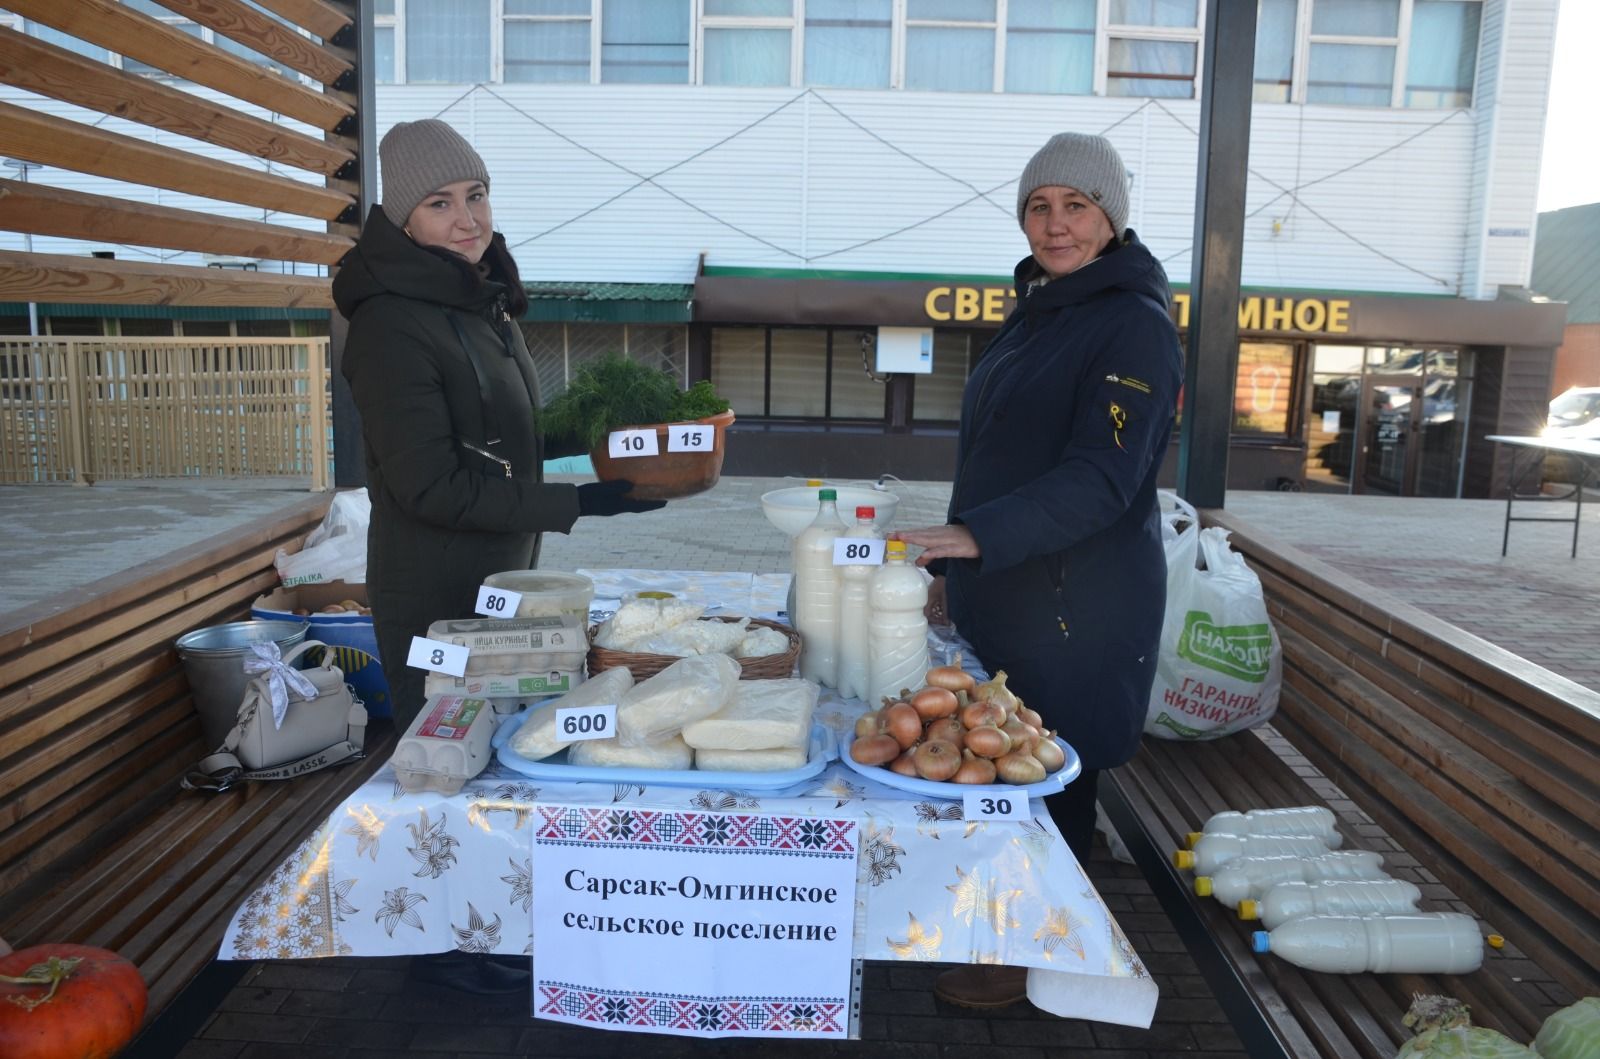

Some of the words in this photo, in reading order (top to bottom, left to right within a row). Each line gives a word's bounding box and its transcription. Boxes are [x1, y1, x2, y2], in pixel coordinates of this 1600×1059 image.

[925, 287, 1017, 322] СВЕ
[1172, 293, 1350, 333] ТМНОЕ
[621, 436, 645, 451] 10
[681, 432, 702, 447] 15
[846, 544, 871, 559] 80
[486, 594, 506, 612] 80
[495, 634, 529, 645] КУРИНЫЕ
[430, 649, 445, 666] 8
[1182, 677, 1261, 710] ГАРАНТИ
[1164, 688, 1234, 723] НИЗКИХ
[563, 713, 607, 735] 600
[980, 798, 1012, 815] 30
[564, 869, 838, 903] Сарсак-Омгинское
[563, 911, 685, 936] сельское
[693, 920, 838, 941] поселение
